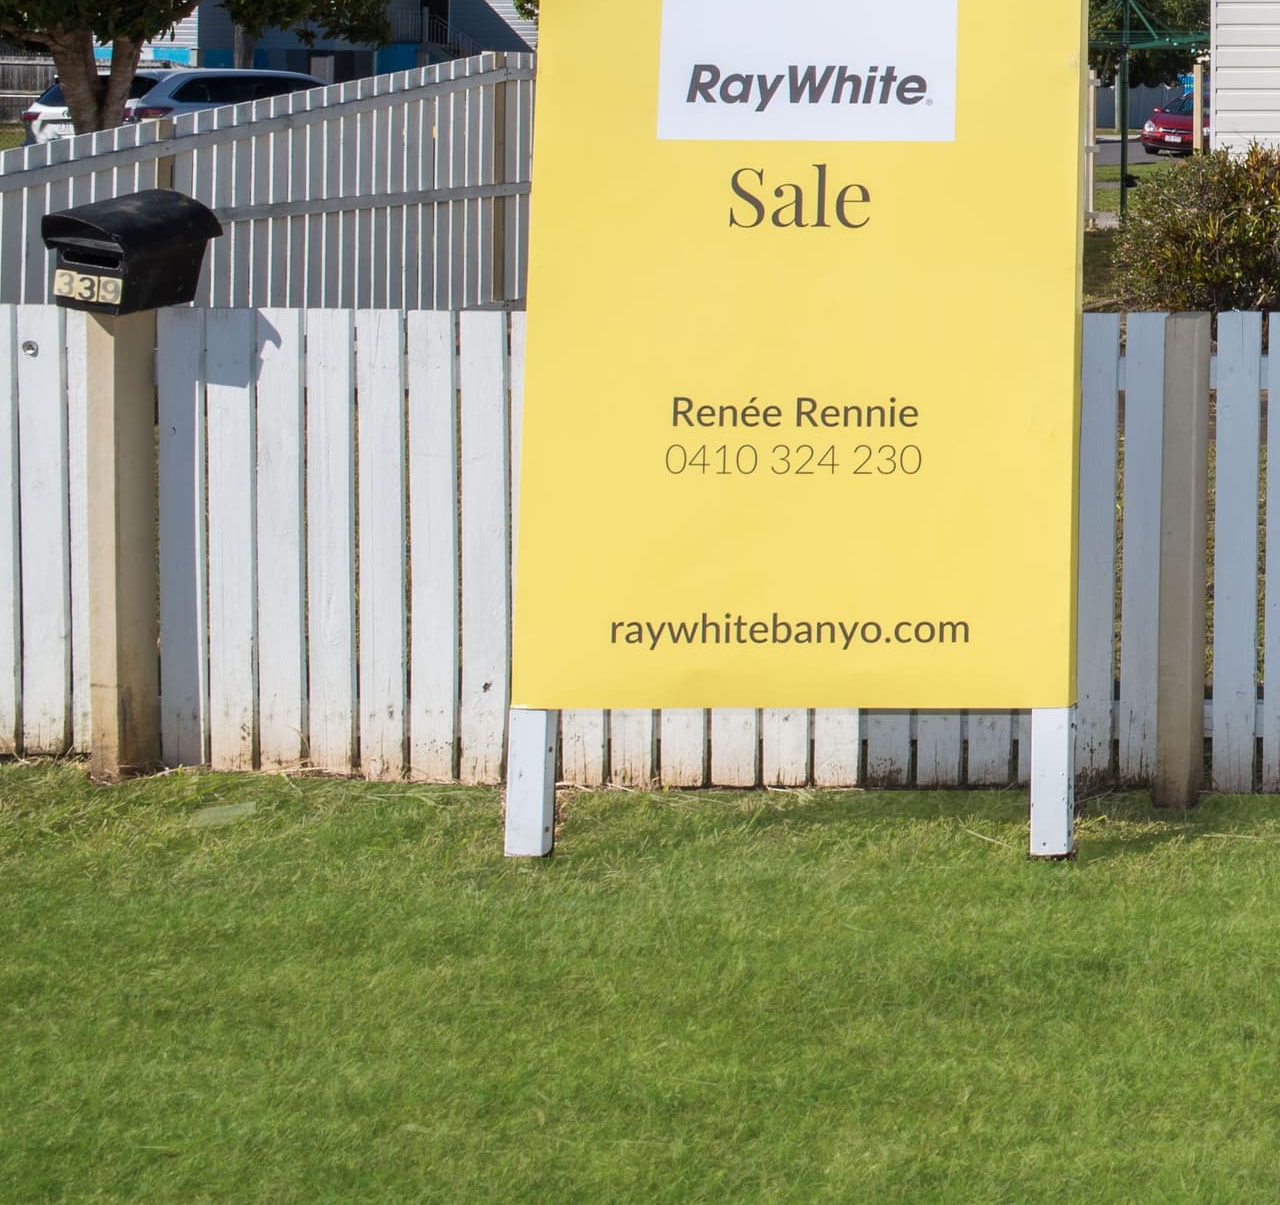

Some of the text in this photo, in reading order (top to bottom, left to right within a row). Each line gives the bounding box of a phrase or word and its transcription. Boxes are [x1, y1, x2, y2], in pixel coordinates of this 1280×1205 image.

[728, 163, 871, 229] Sale
[56, 271, 121, 303] 339
[671, 396, 919, 428] Renée Rennie
[665, 443, 922, 475] 0410 324 230
[610, 612, 970, 652] raywhitebanyo.com
